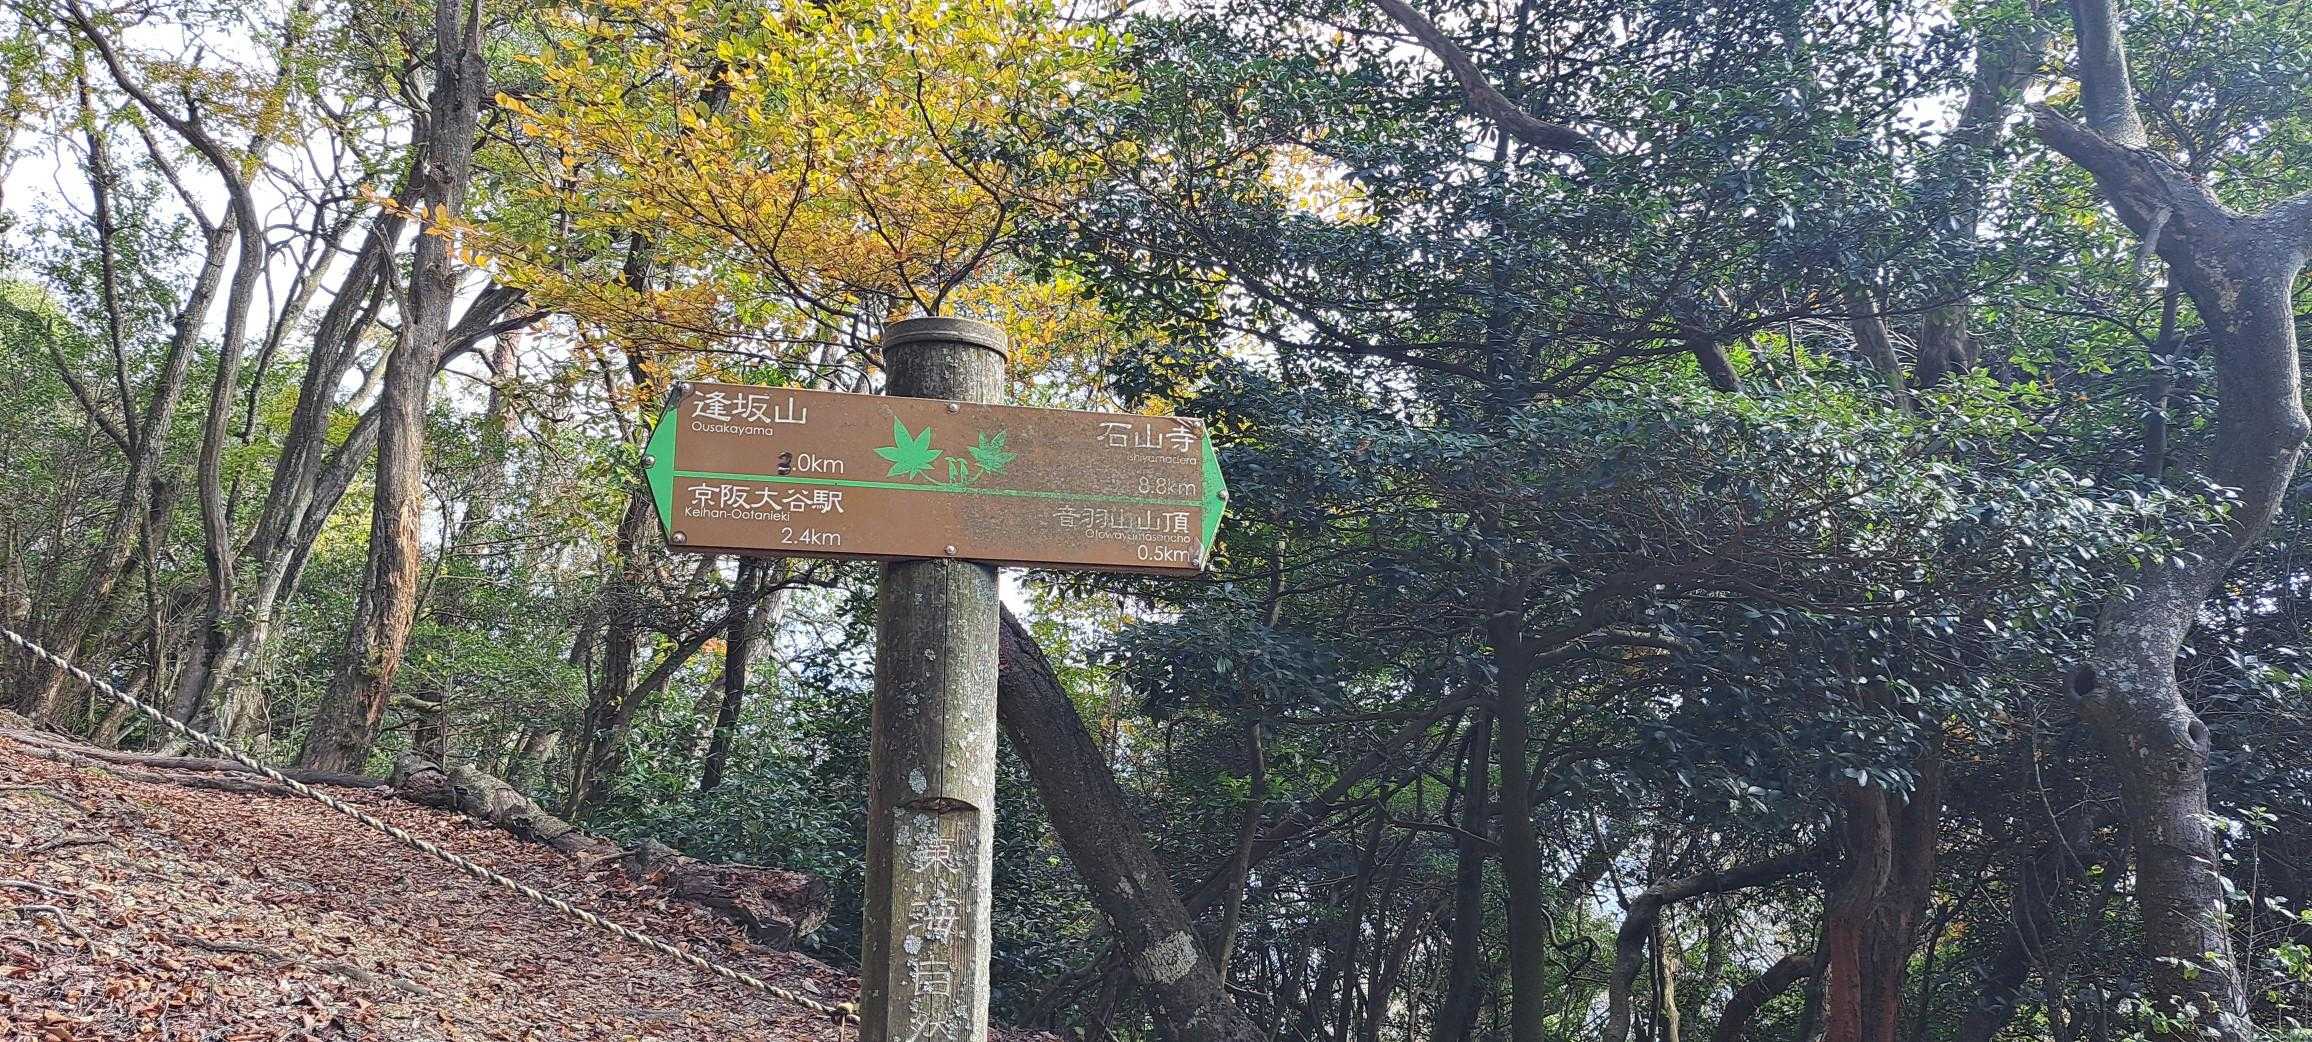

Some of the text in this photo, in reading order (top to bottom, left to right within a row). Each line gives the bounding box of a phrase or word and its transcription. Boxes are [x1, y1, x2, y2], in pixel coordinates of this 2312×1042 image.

[692, 390, 808, 425] 逢坂山
[691, 421, 774, 436] Ousakayama
[1097, 422, 1196, 452] 石山寺
[1138, 476, 1196, 496] 8.8km
[688, 483, 844, 513] 京阪大谷駅
[685, 506, 791, 522] Keihan-Ootanieki
[1053, 505, 1190, 533] 音羽山山頂
[781, 527, 841, 546] 2.4km
[1137, 544, 1190, 562] 0.5km
